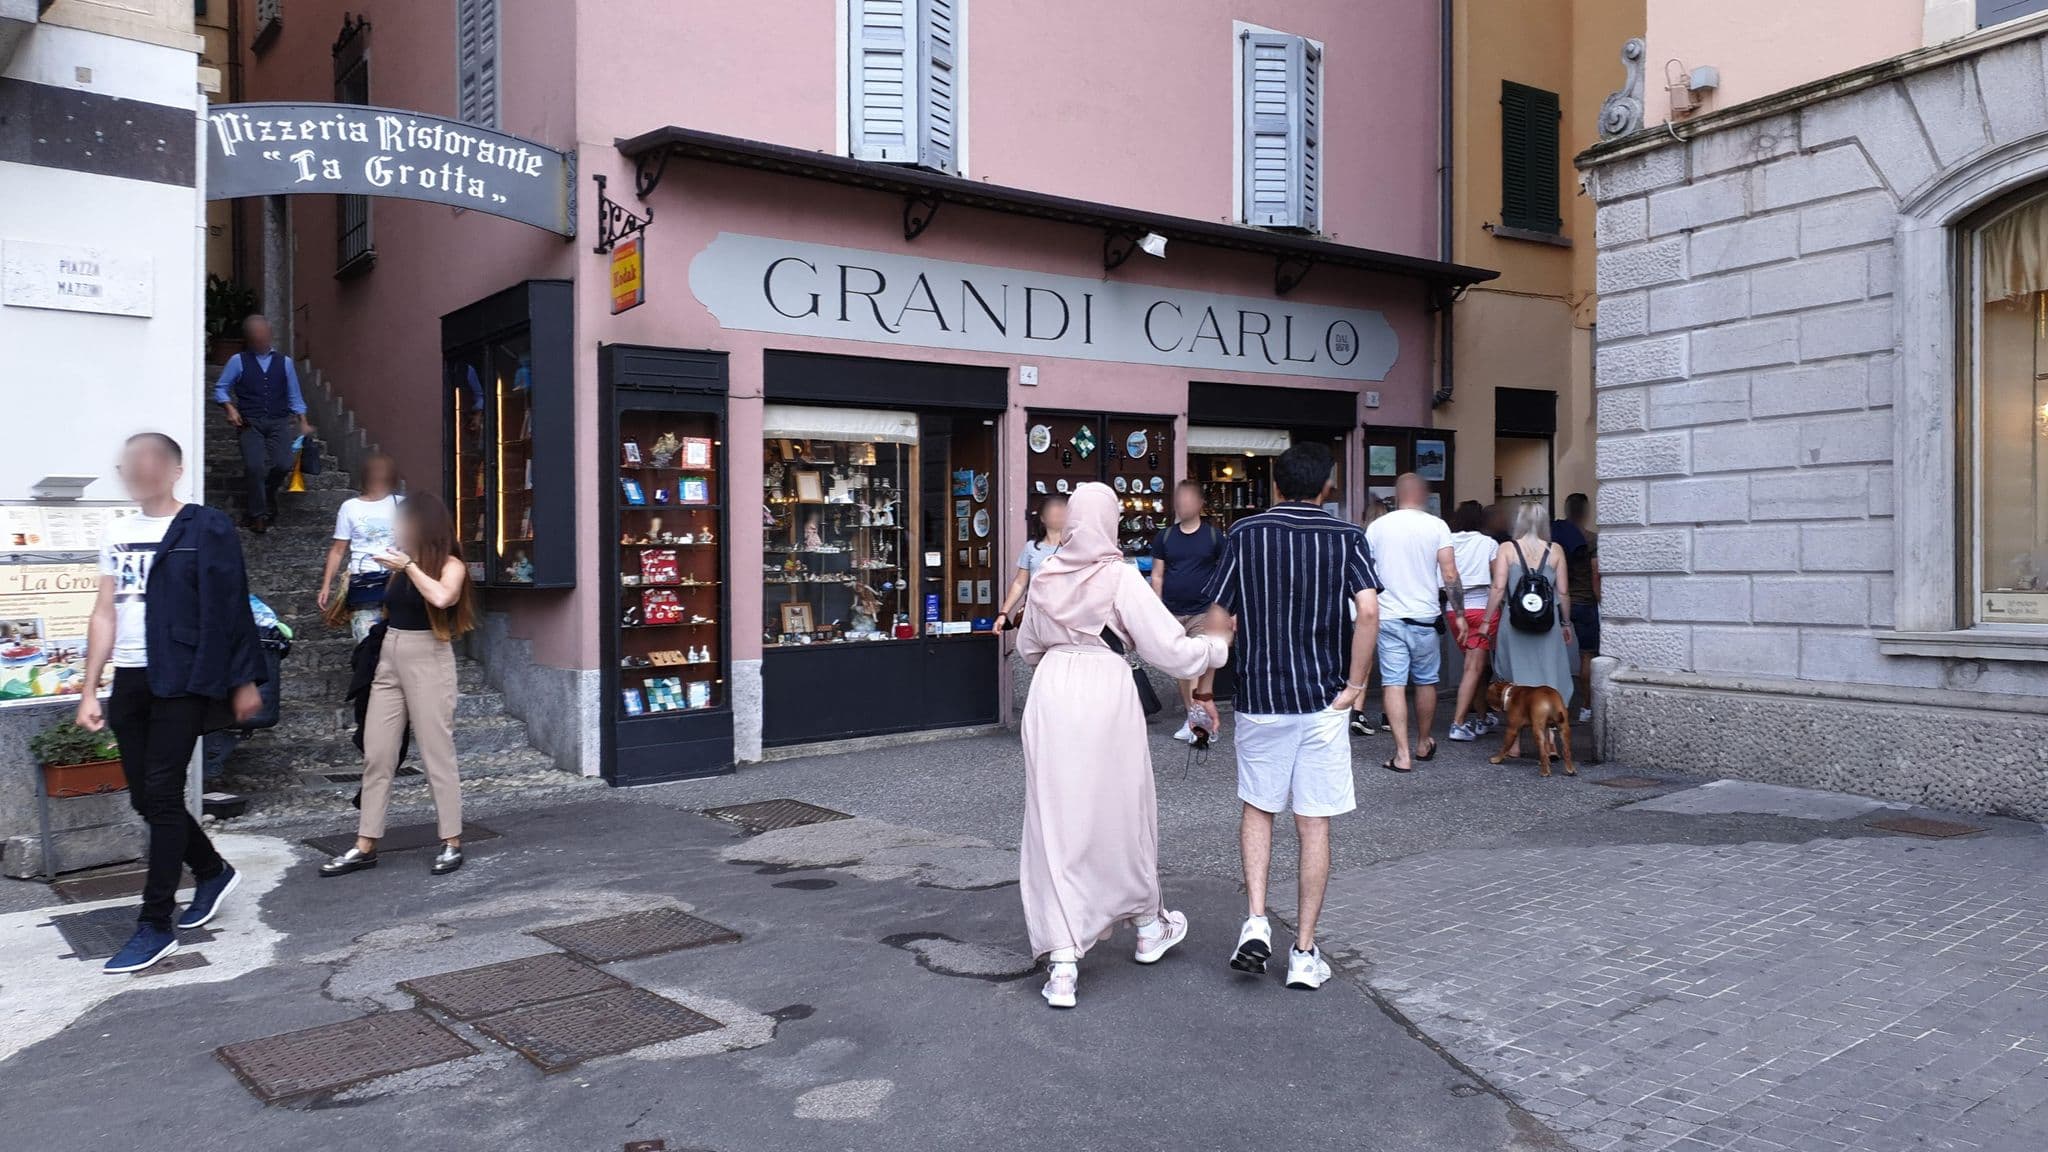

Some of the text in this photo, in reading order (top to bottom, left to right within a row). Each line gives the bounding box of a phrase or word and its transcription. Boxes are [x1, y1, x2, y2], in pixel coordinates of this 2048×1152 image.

[209, 112, 544, 178] Pizzeria Ristorante
[57, 280, 103, 298] MAZZ
[59, 259, 101, 277] PIAZZA
[763, 256, 1360, 366] GRANDI CARLO
